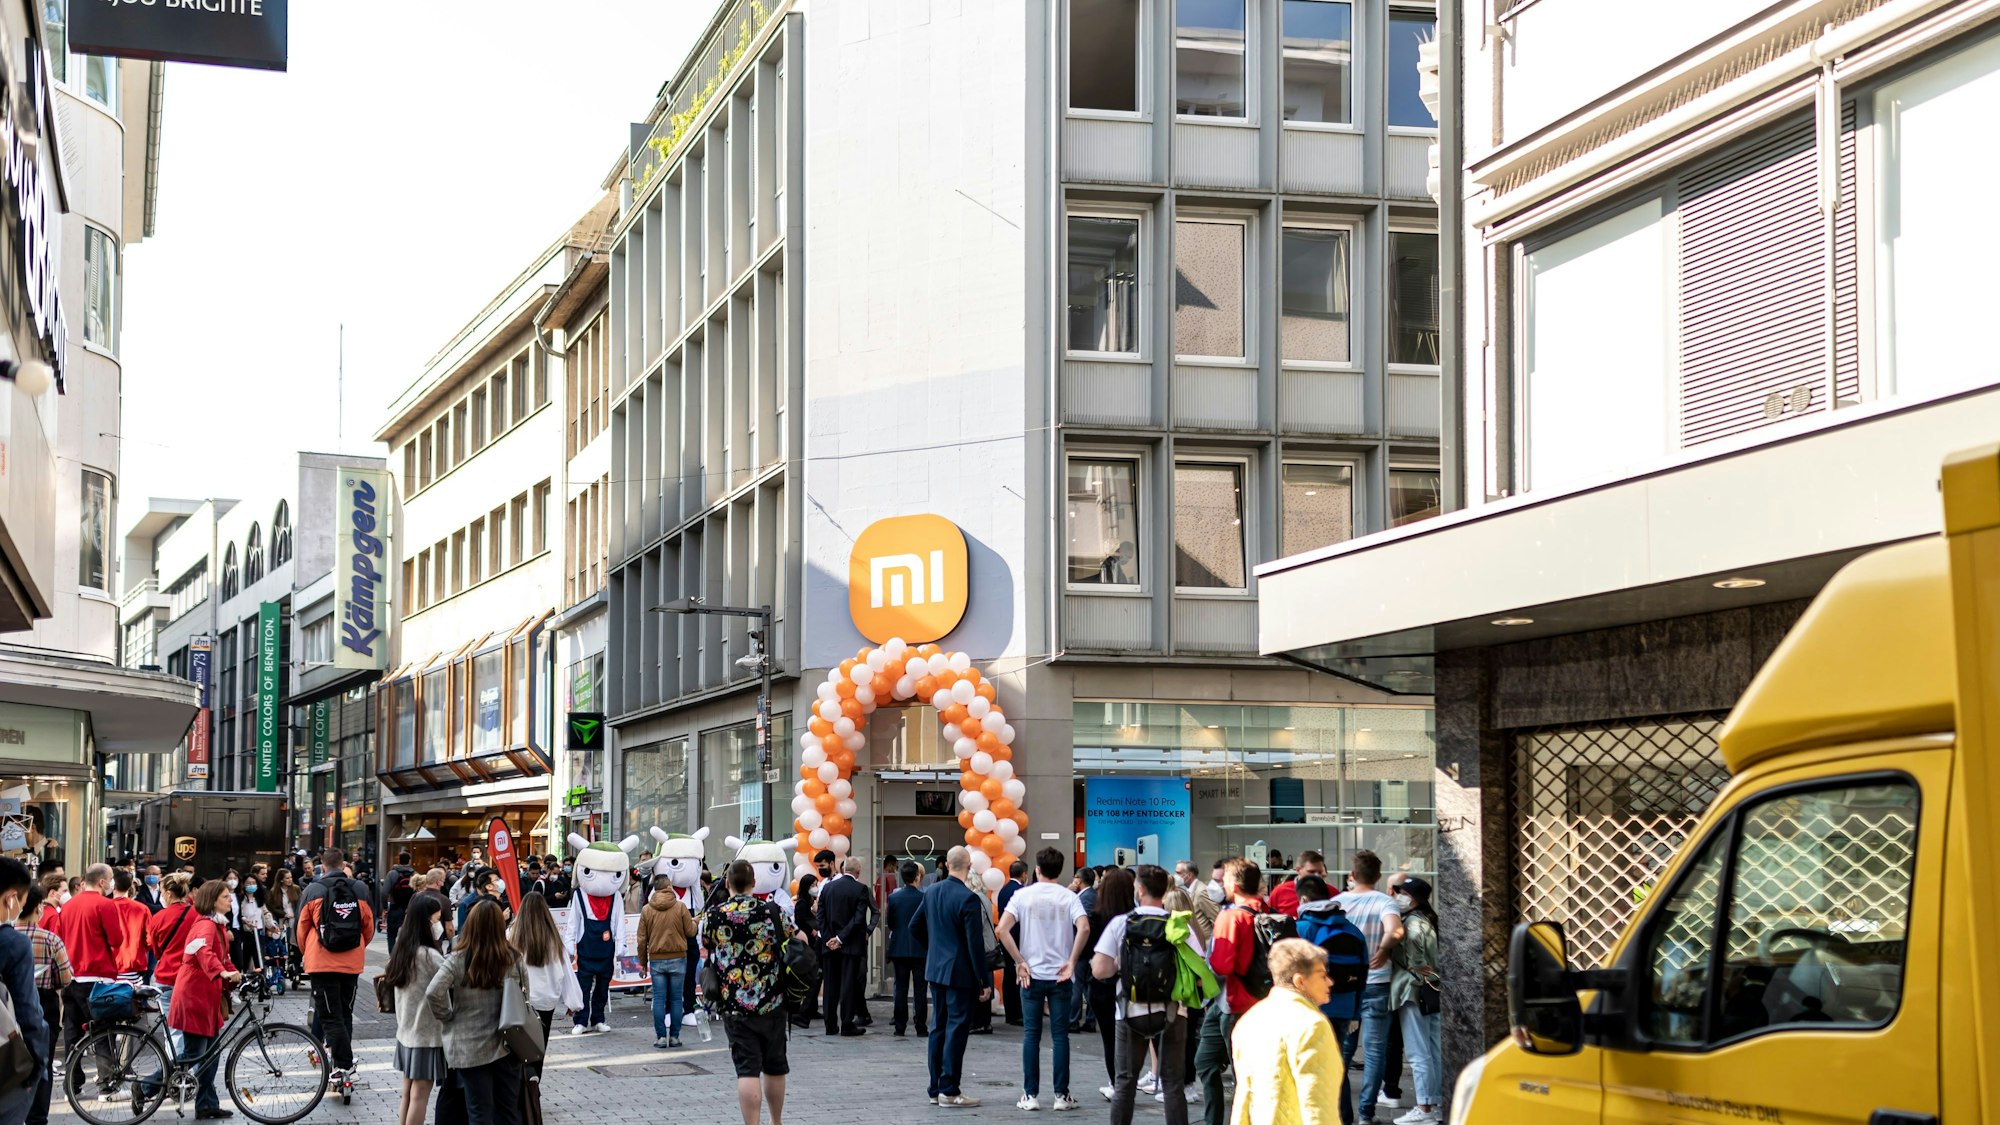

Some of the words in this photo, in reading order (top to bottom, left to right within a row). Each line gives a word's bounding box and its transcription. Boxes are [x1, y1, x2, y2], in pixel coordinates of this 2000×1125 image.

[342, 480, 383, 657] Kämpgen
[194, 637, 208, 646] dm
[264, 675, 273, 691] OF
[263, 694, 273, 736] COLORS
[262, 742, 272, 778] UNITED
[191, 765, 206, 774] dm
[1199, 788, 1219, 799] SMART
[1096, 797, 1123, 806] Redmi
[1125, 797, 1146, 806] Note
[1150, 797, 1159, 806] 10
[1162, 798, 1176, 807] Pro
[1136, 810, 1185, 818] ENTDECKER
[176, 843, 195, 857] ups
[1666, 1090, 1722, 1113] Deutsche
[1724, 1100, 1752, 1118] Post
[1757, 1103, 1784, 1124] DHL
